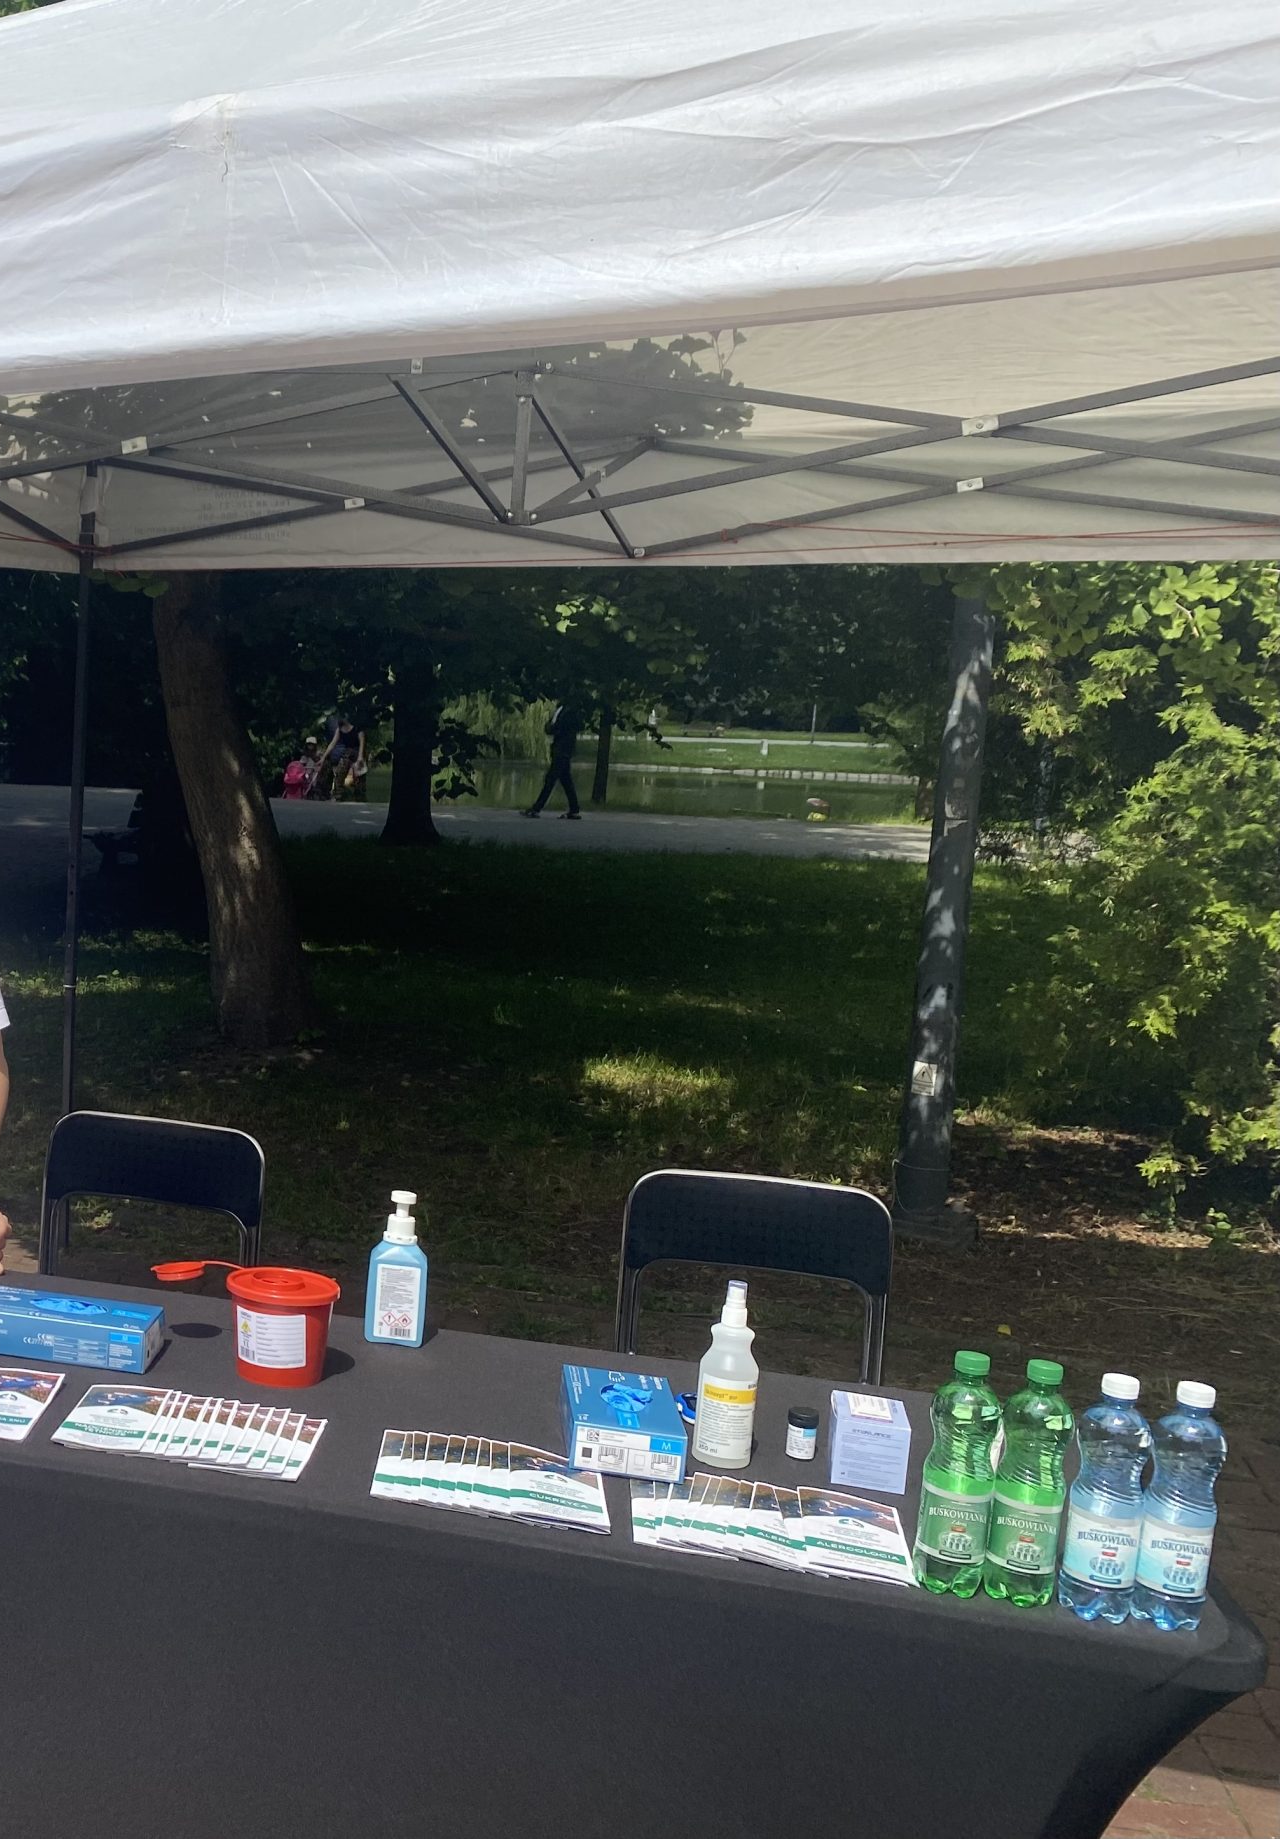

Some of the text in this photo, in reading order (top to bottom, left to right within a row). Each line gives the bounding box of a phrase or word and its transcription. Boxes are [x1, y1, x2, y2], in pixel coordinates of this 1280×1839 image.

[661, 1442, 672, 1451] M
[528, 1492, 589, 1510] CUKRZYCA
[816, 1540, 900, 1561] ALERGOLOGIA
